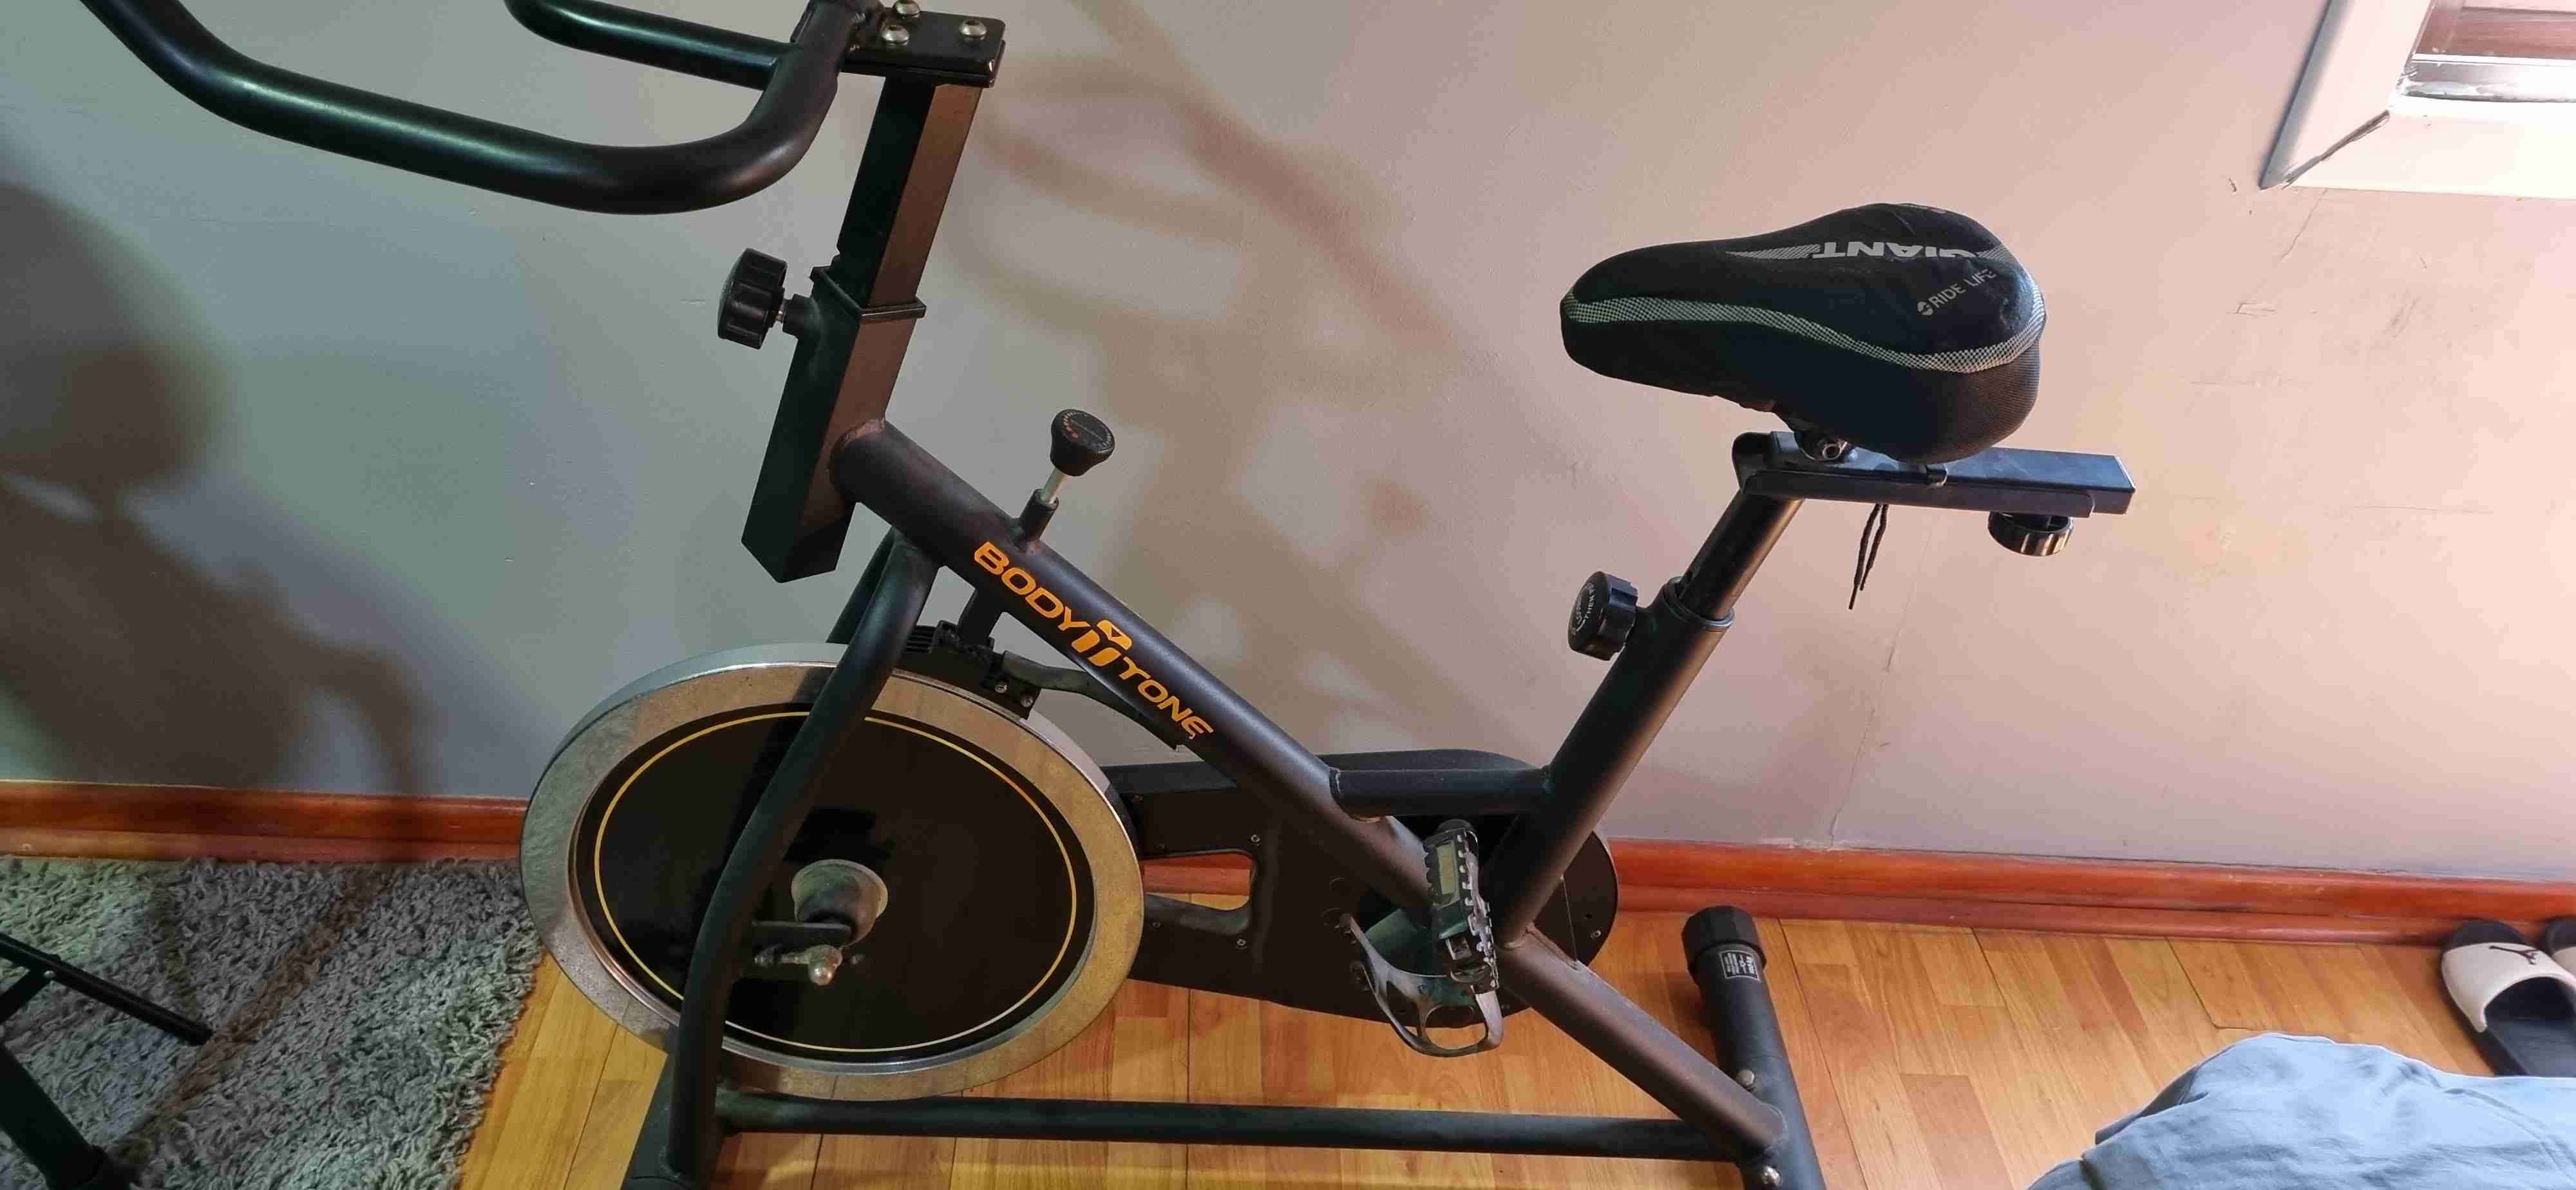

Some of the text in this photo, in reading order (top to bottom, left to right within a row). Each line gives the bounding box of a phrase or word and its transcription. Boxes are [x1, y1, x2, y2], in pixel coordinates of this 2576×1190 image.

[1928, 283, 1966, 309] RIDE
[974, 542, 1214, 739] BODY TONE
